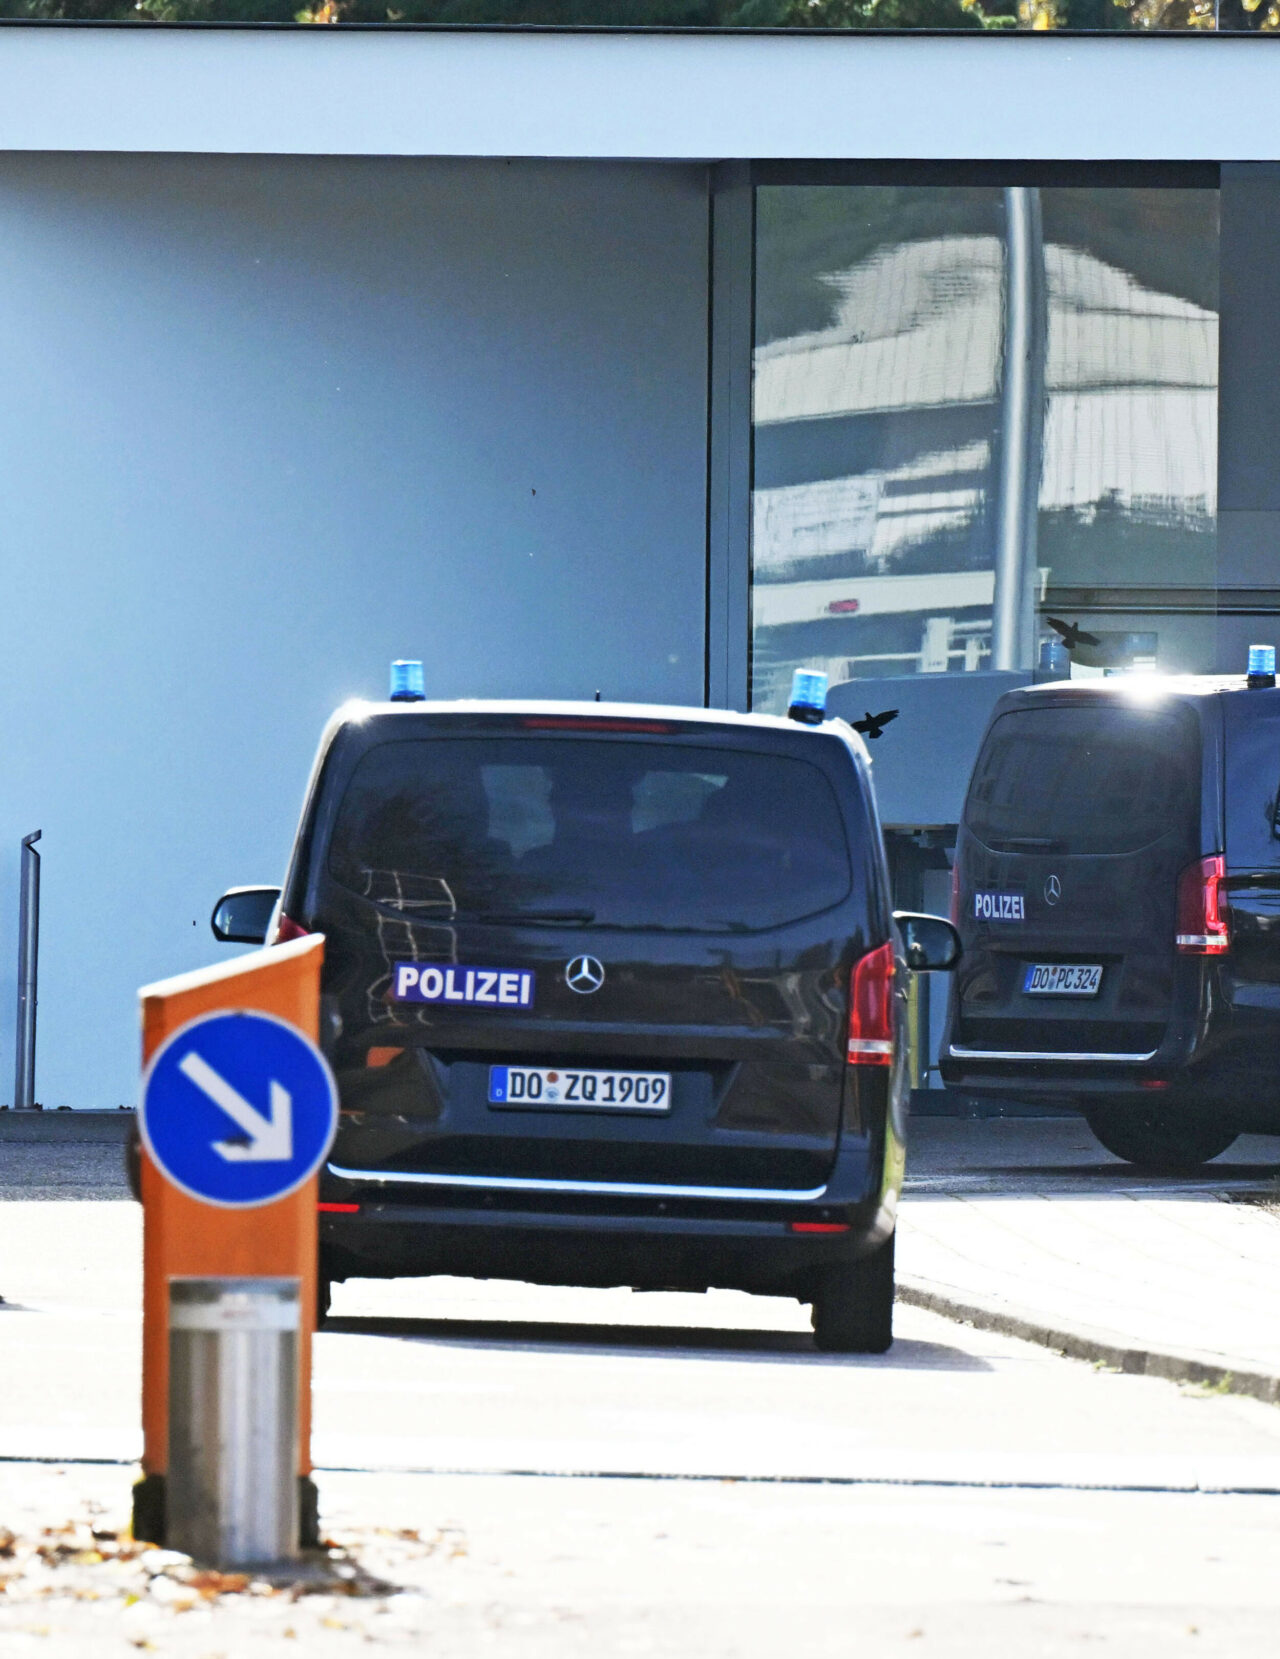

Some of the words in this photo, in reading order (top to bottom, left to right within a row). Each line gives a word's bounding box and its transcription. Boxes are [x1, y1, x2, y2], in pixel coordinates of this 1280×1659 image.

[975, 894, 1025, 920] POLIZEI
[397, 966, 531, 1004] POLIZEI
[510, 1072, 542, 1098] DO
[602, 1076, 666, 1104] 1909
